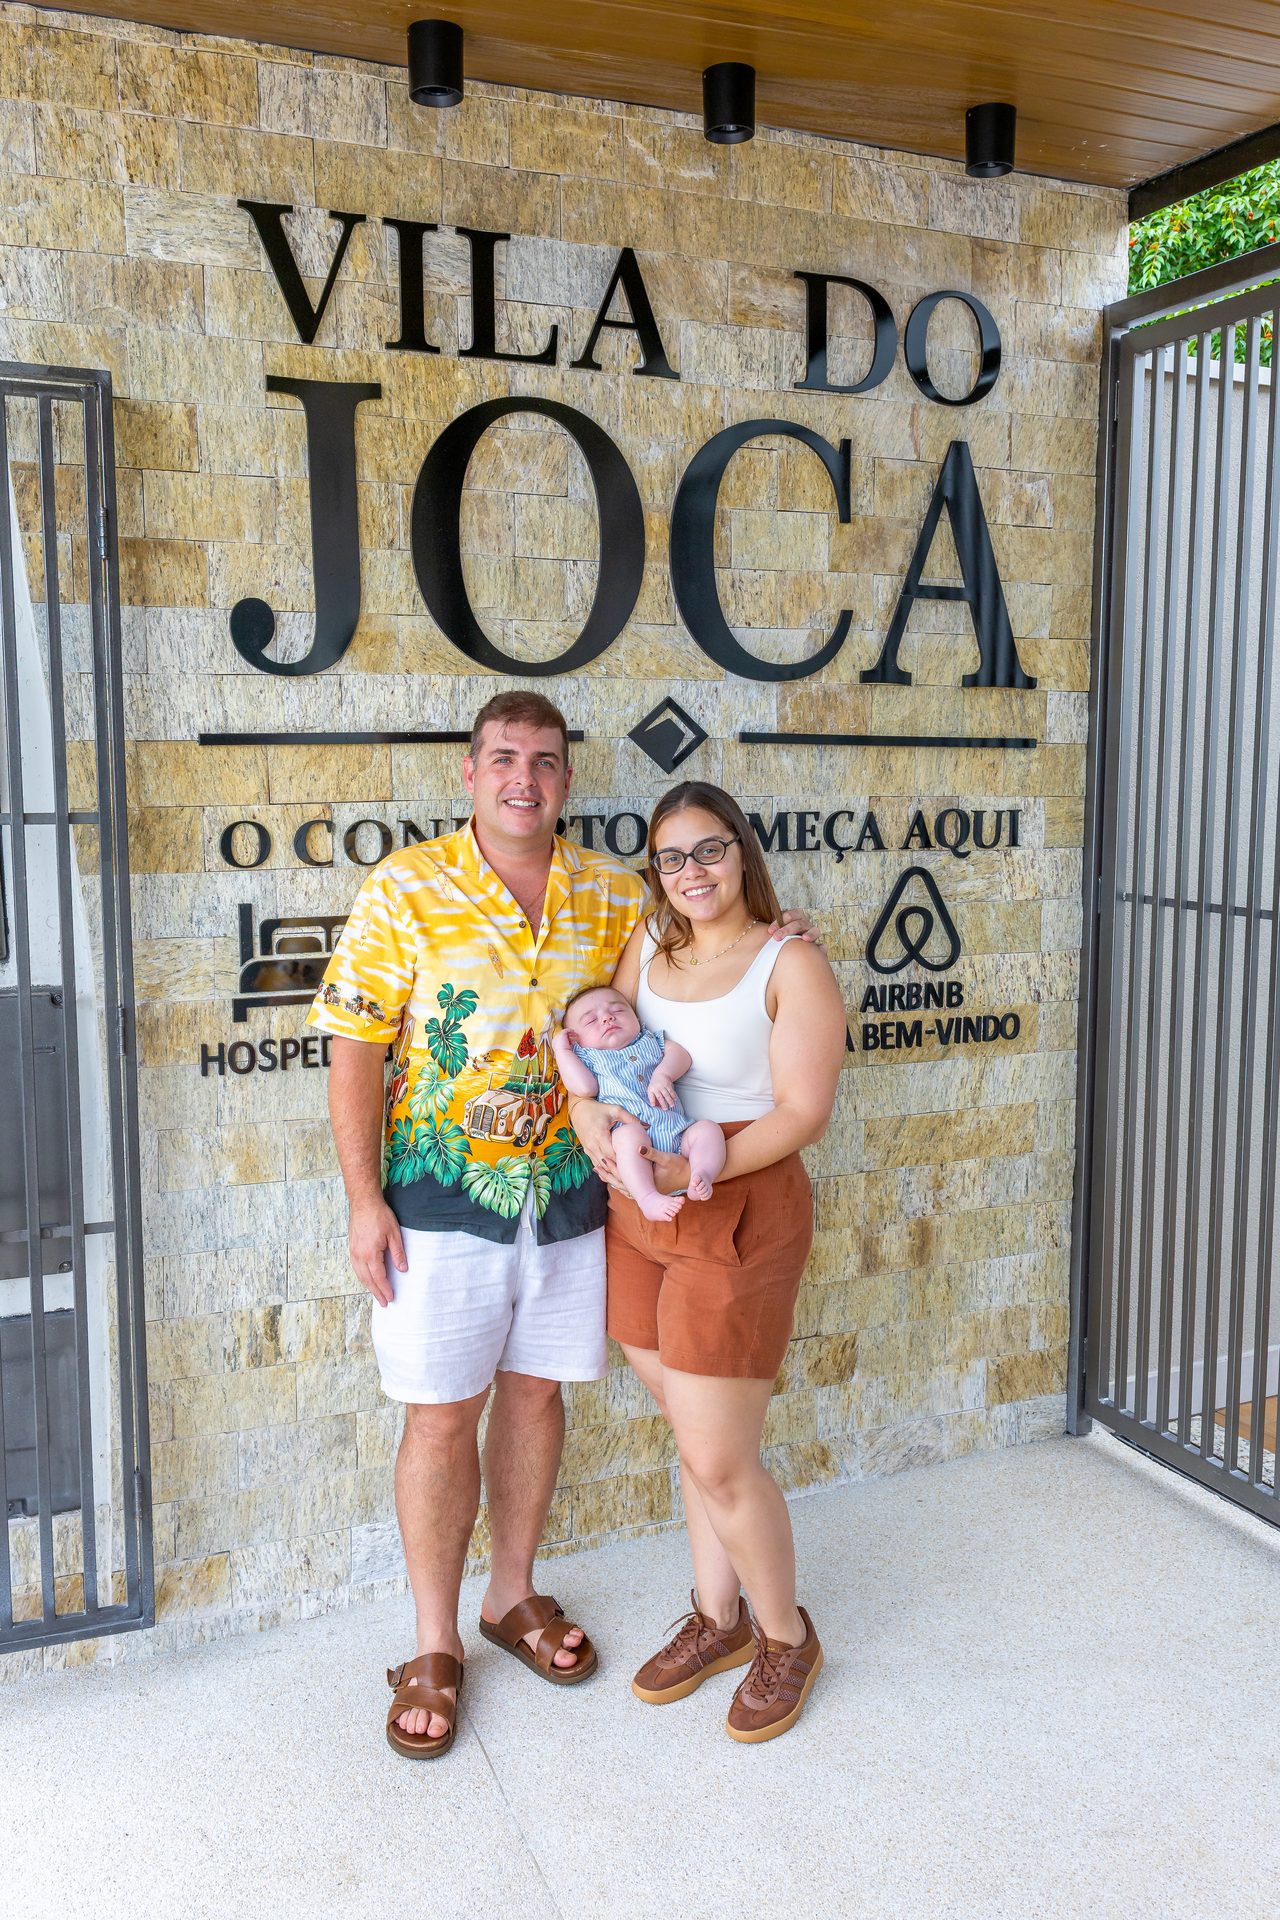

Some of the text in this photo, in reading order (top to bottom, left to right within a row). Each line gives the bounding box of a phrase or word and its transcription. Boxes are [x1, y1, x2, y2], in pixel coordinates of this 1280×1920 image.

[237, 199, 1002, 407] VILA DO
[229, 374, 1039, 690] JOCA
[220, 808, 1023, 869] O CONTO MEÇA AQUI
[859, 980, 965, 1013] AIRBNB
[862, 1012, 1021, 1051] BEM-VINDO
